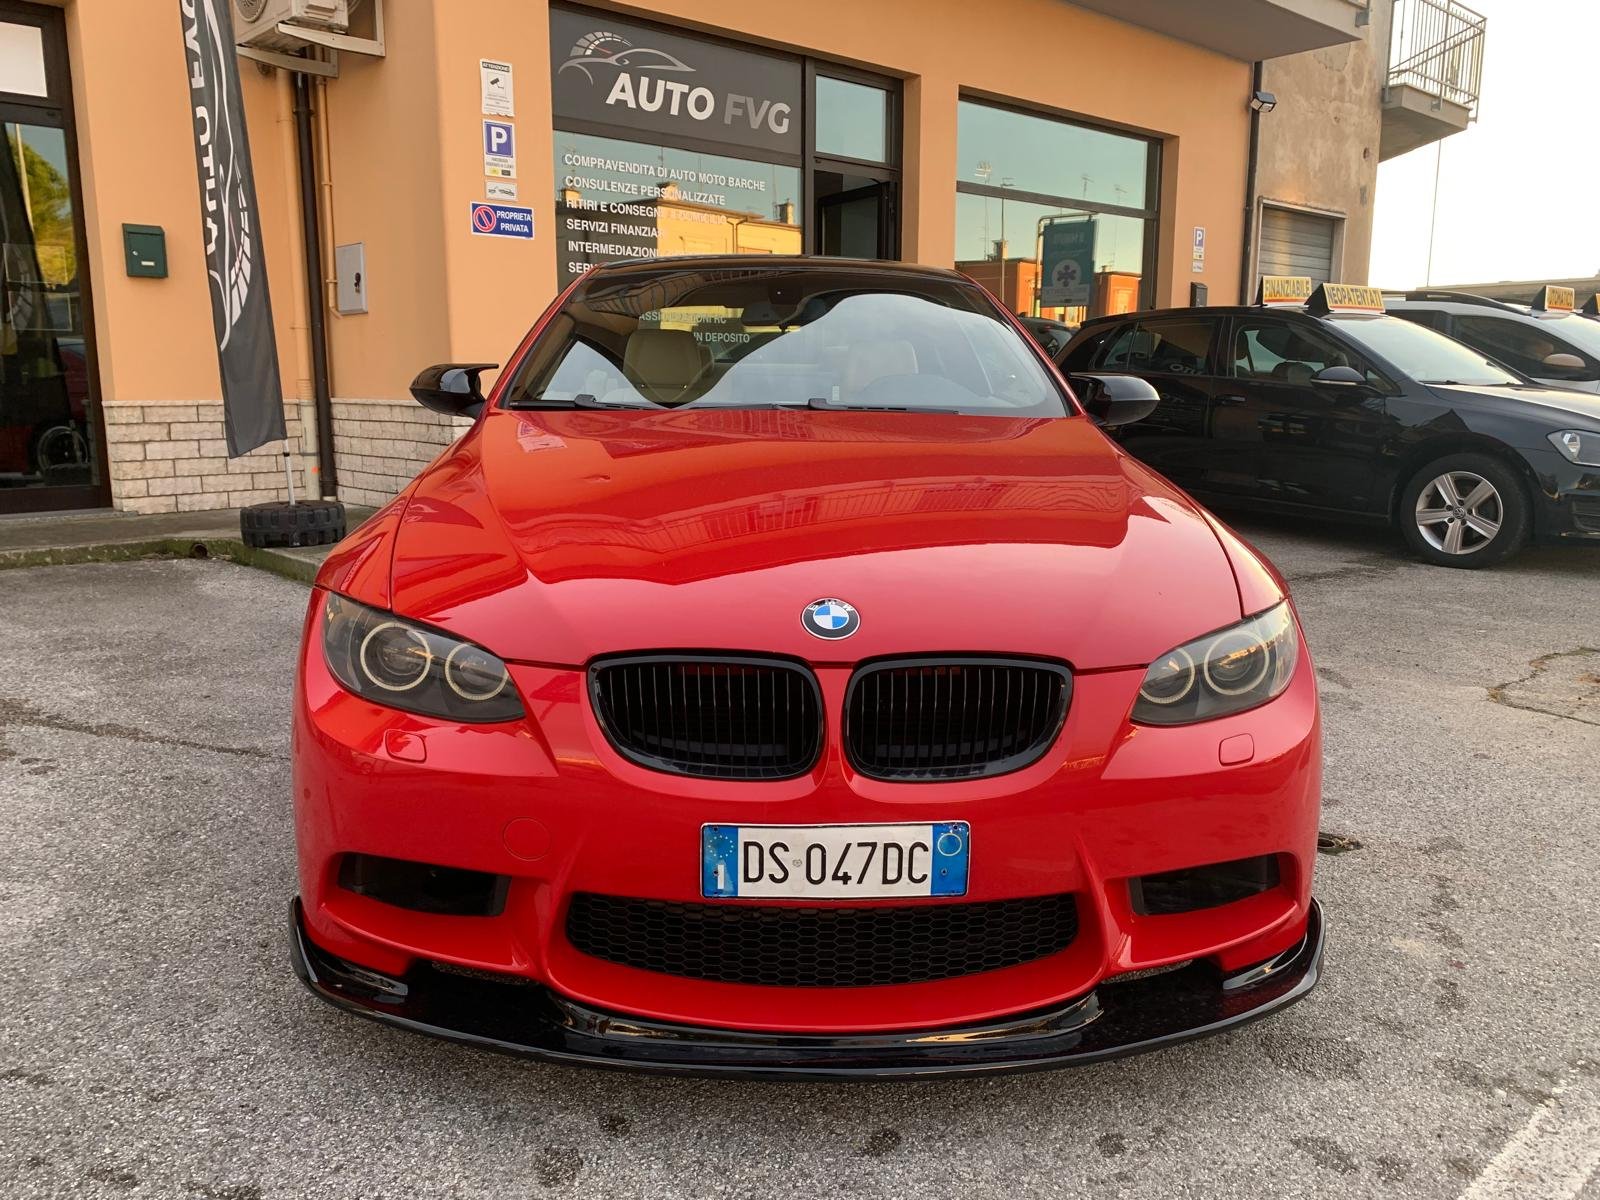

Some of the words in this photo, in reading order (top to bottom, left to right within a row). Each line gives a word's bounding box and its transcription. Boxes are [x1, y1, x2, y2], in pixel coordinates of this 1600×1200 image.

[605, 72, 715, 121] AUTO
[724, 93, 792, 134] FVG
[490, 126, 508, 152] P
[564, 153, 657, 176] COMPRAVENDITA
[657, 167, 668, 178] DI
[669, 168, 696, 183] AUTO
[698, 172, 726, 186] MOTO
[728, 176, 766, 191] BARCHE
[565, 175, 638, 195] CONSULENZE
[640, 184, 726, 206] PERSONALIZZATE
[566, 198, 598, 211] RITIRI
[600, 202, 608, 211] E
[500, 222, 529, 233] PRIVATA
[566, 219, 609, 233] SERVIZI
[1195, 230, 1203, 245] P
[1264, 279, 1310, 298] FINANZIABILE
[1325, 286, 1383, 306] NEOPATENTATI
[705, 332, 750, 343] DEPOSITO
[743, 841, 790, 884] DS
[805, 841, 929, 885] 047DC
